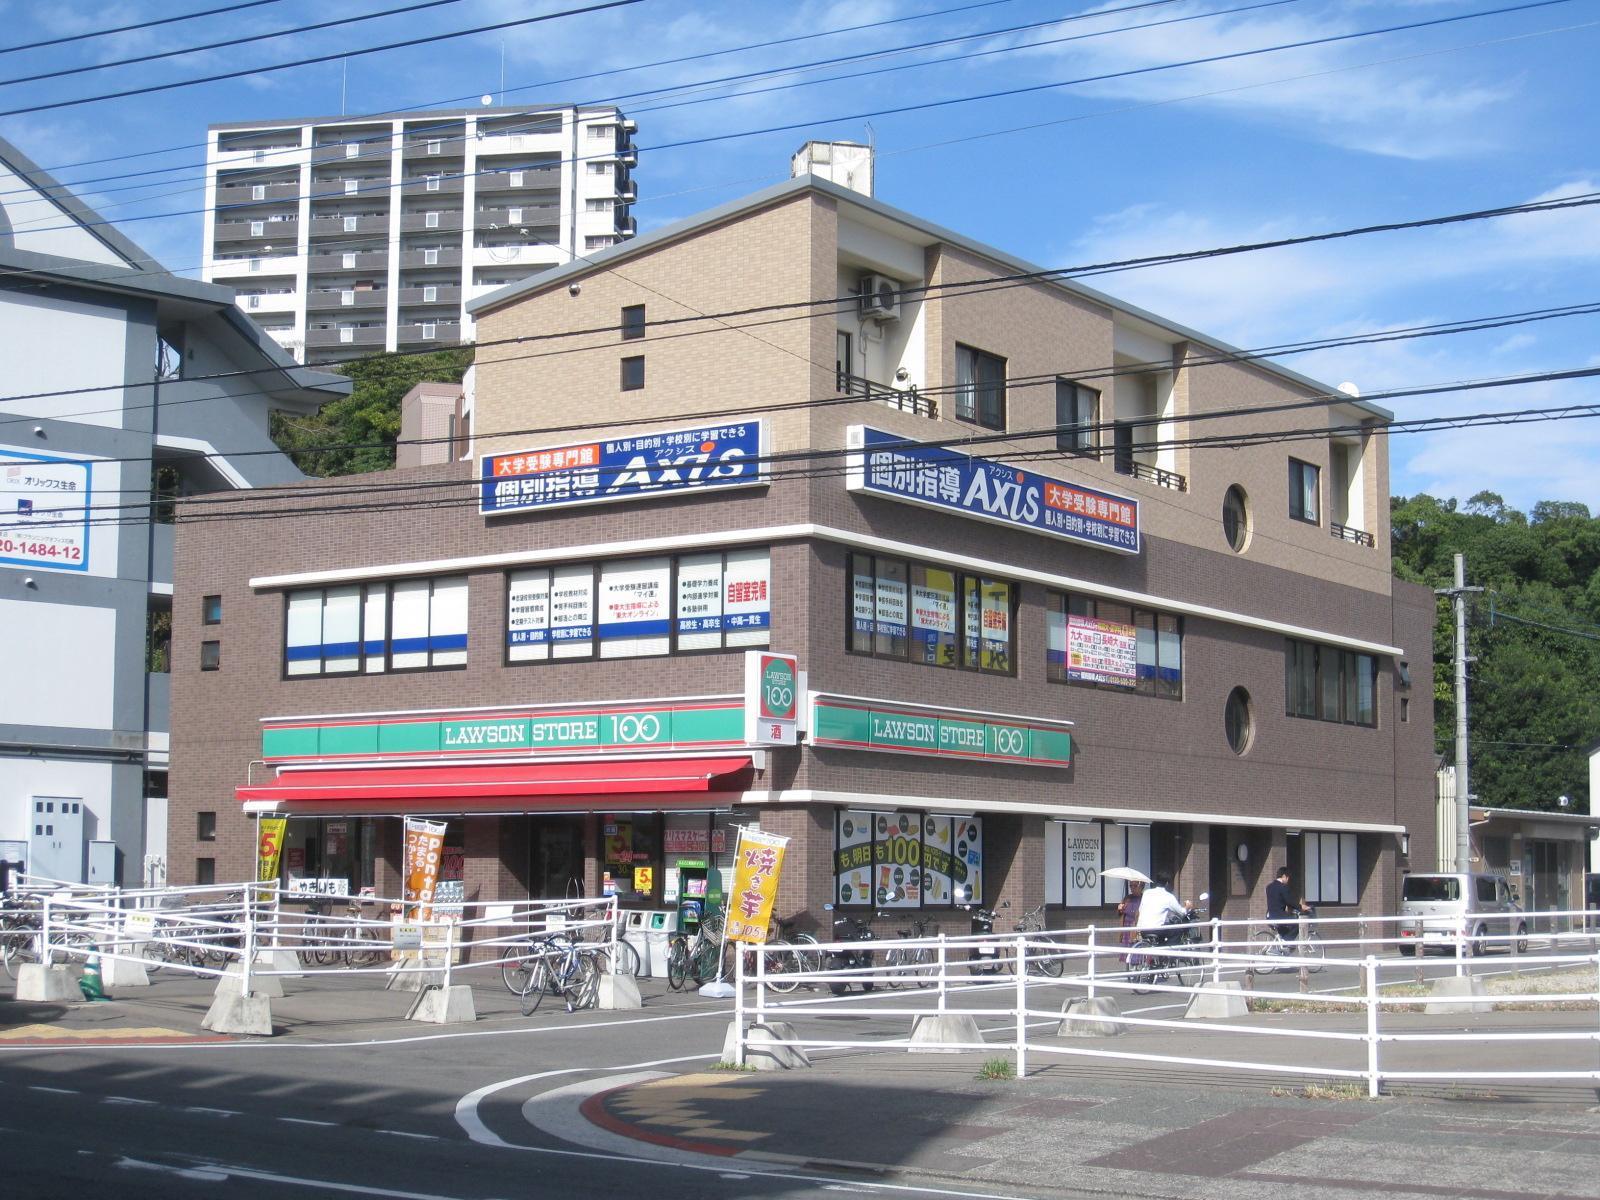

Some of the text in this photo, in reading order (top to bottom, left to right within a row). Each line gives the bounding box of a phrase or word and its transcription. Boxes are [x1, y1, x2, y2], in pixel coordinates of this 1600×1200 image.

[606, 426, 746, 454] 個人別・目的別・学校別に学習できる
[654, 445, 696, 458] アクシス
[499, 448, 594, 475] 大学受験専門館
[989, 465, 1014, 481] アクシス
[25, 476, 77, 491] オリックス生命
[495, 468, 599, 507] 個別指導
[869, 452, 961, 503] 個別指導
[1049, 487, 1131, 525] 大学受験専門館
[1045, 510, 1136, 546] 個人別・目的別・学校別に学習できる
[727, 580, 767, 604] 自習室完備
[766, 671, 792, 680] LAWSON
[766, 685, 792, 707] 100
[445, 714, 660, 745] LAWSON STORE 100
[770, 724, 782, 739] 酒
[874, 718, 1024, 754] LAWSON STORE 100
[1067, 838, 1100, 850] LAWSON
[1072, 852, 1095, 861] STORE
[420, 837, 441, 901] Ponta
[1070, 866, 1097, 889] 100
[299, 881, 337, 896] やきいも
[740, 847, 777, 919] 焼き芋
